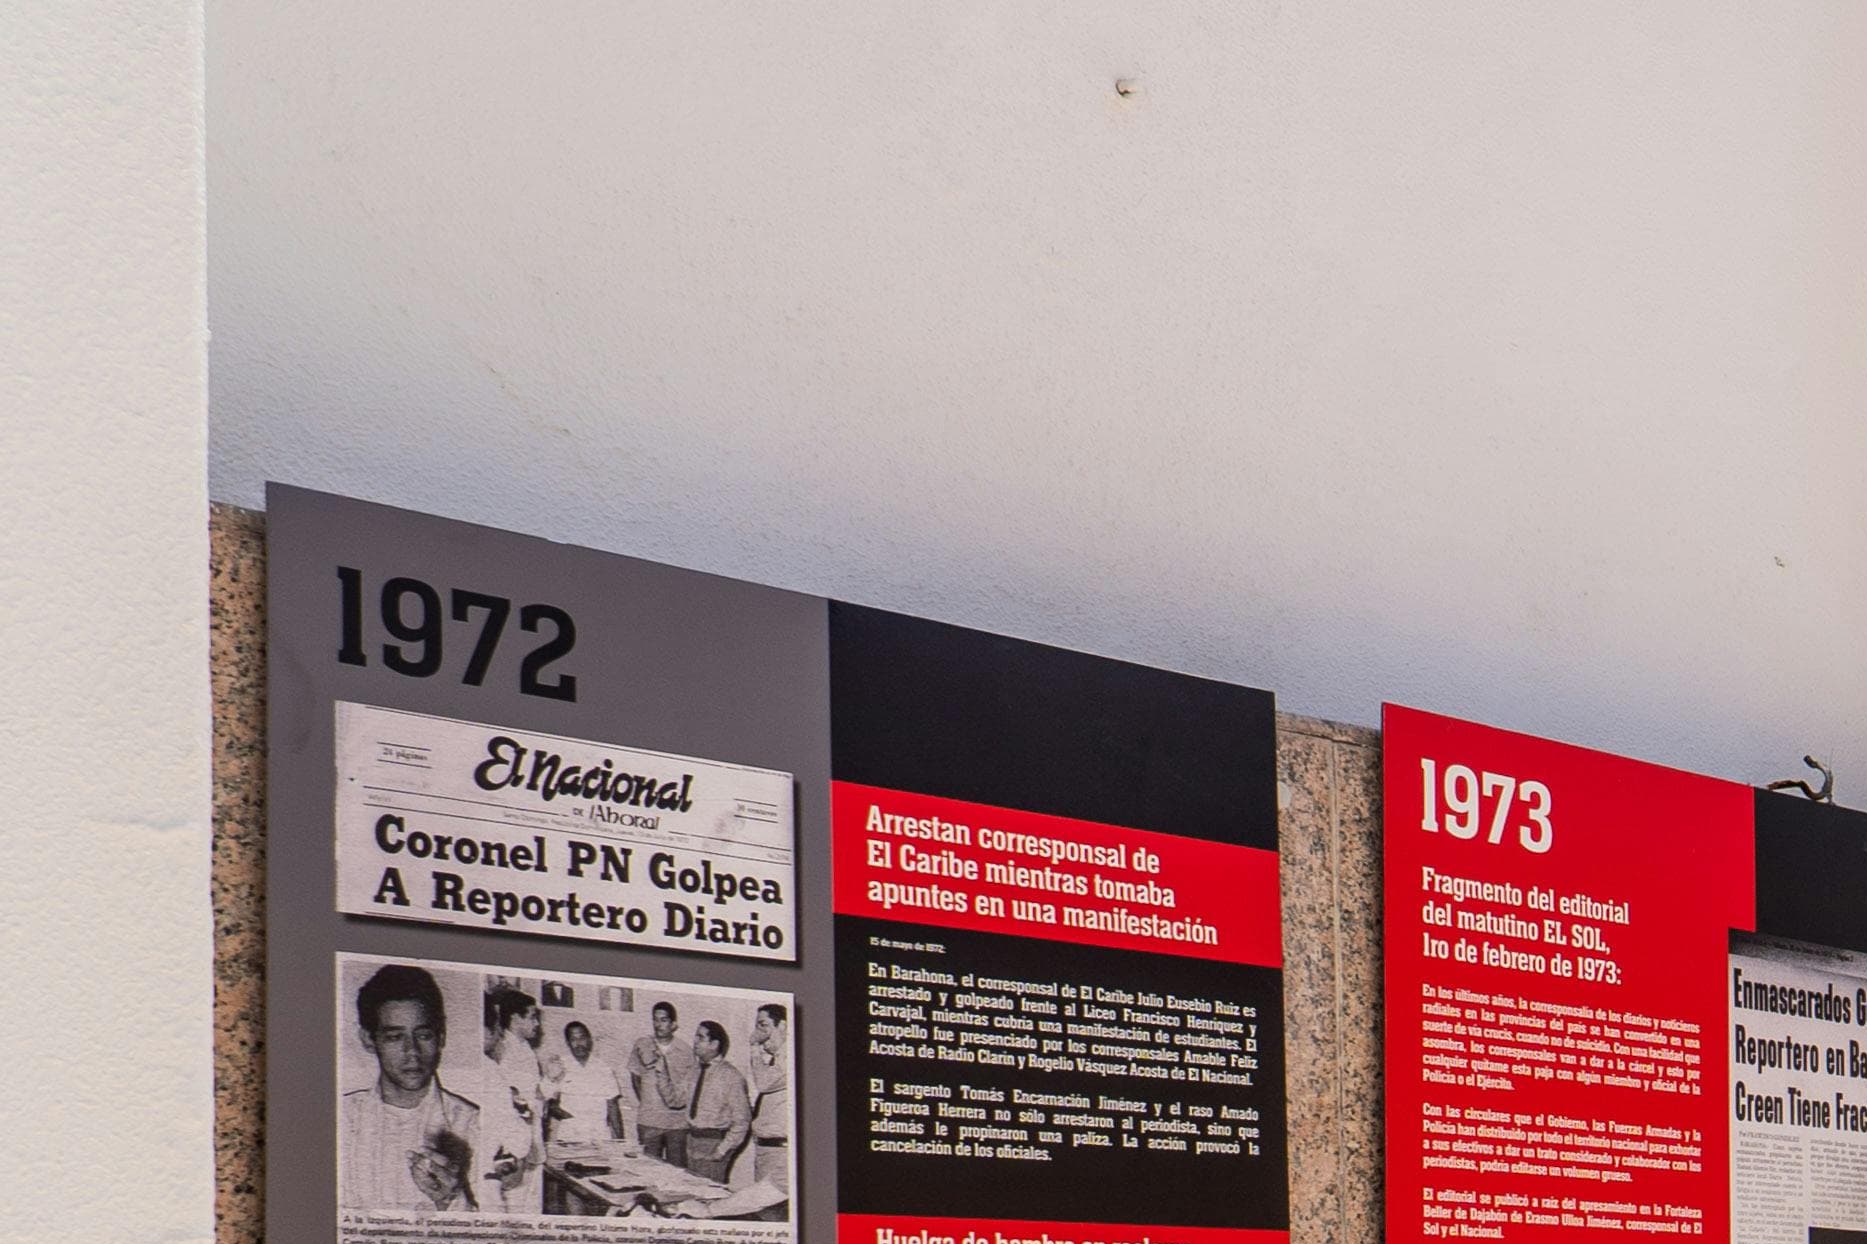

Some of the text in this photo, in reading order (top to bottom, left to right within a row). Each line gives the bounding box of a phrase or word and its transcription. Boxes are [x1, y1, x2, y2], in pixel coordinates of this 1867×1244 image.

[336, 566, 578, 703] 1972
[474, 736, 694, 813] El Nacional
[1421, 757, 1554, 855] 1973
[374, 813, 782, 904] Coronel PN Golpea
[865, 804, 1159, 873] Arrestan corresponsal de
[866, 839, 1175, 907] El Caribe mientras tomaba
[1422, 866, 1629, 924] Fragmento del editorial
[373, 866, 782, 949] A Reportero Diario
[867, 880, 1217, 944] apuntes en una manifestación
[1422, 900, 1610, 954] del matutino EL SOL,
[1423, 932, 1620, 984] 1ro de febrero de 1973:
[868, 961, 1256, 1017] En Barahona, el corresponsal de El Caribe Julio Eusebio Ruiz es
[1733, 967, 1850, 1024] Enmascarados
[1734, 1024, 1818, 1074] Reportero
[1826, 1047, 1844, 1076] en
[1735, 1080, 1783, 1124] Creen
[1787, 1086, 1830, 1128] Tiene
[870, 1139, 1052, 1160] cancelación de los oficiales.
